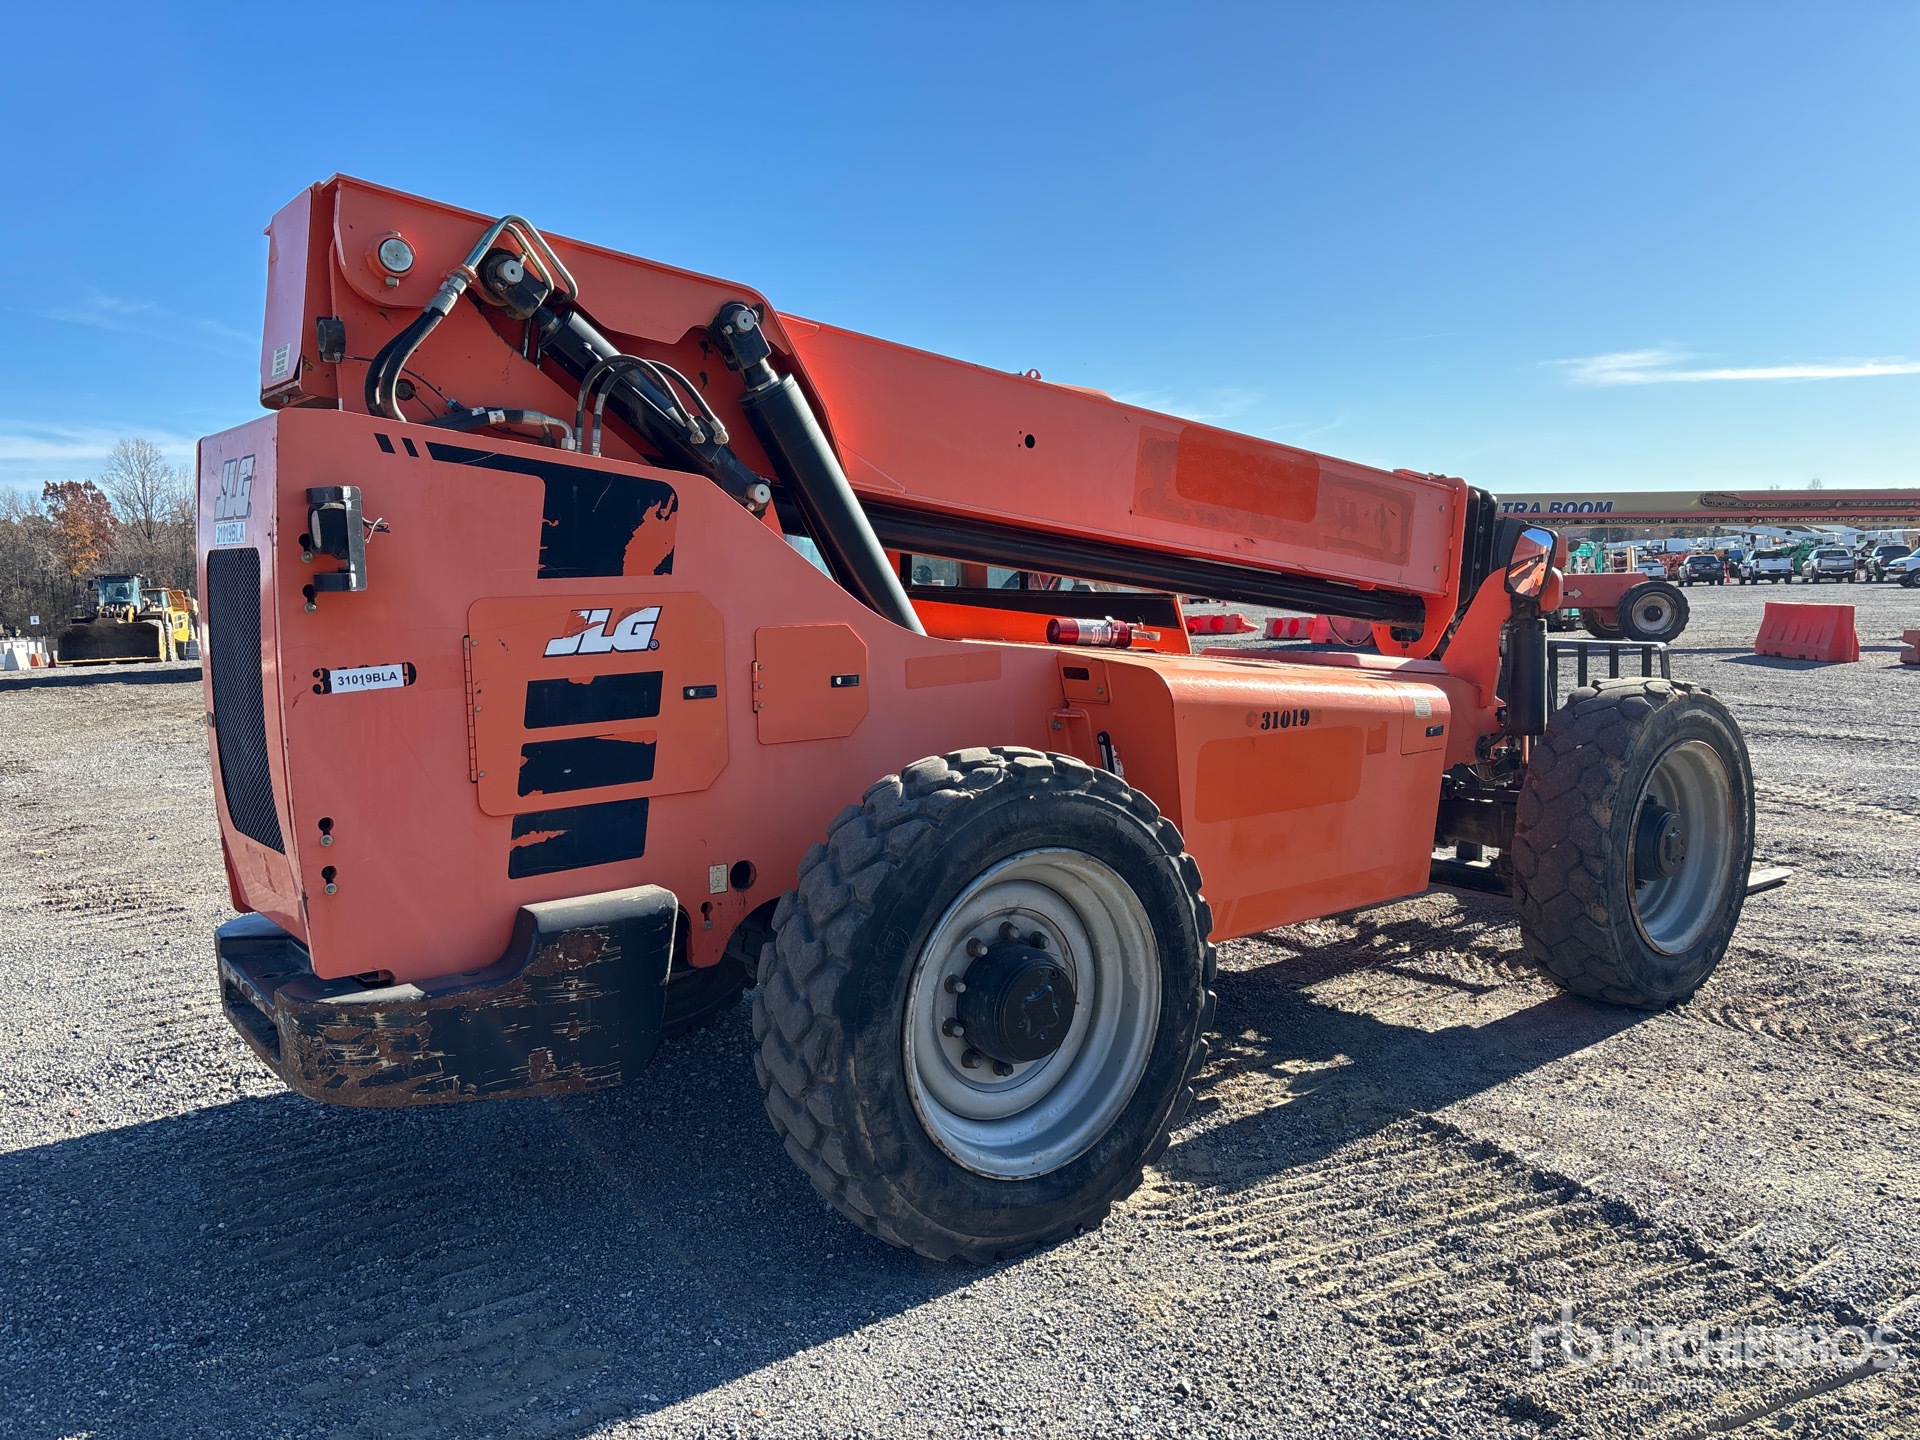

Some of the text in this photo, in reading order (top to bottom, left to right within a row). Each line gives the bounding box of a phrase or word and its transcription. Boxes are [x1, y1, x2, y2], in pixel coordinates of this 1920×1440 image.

[214, 454, 254, 522] JLG
[1496, 501, 1614, 513] TRA BOOM
[542, 606, 662, 658] JLG
[337, 671, 398, 687] 31019BLA
[1261, 708, 1310, 730] 31019
